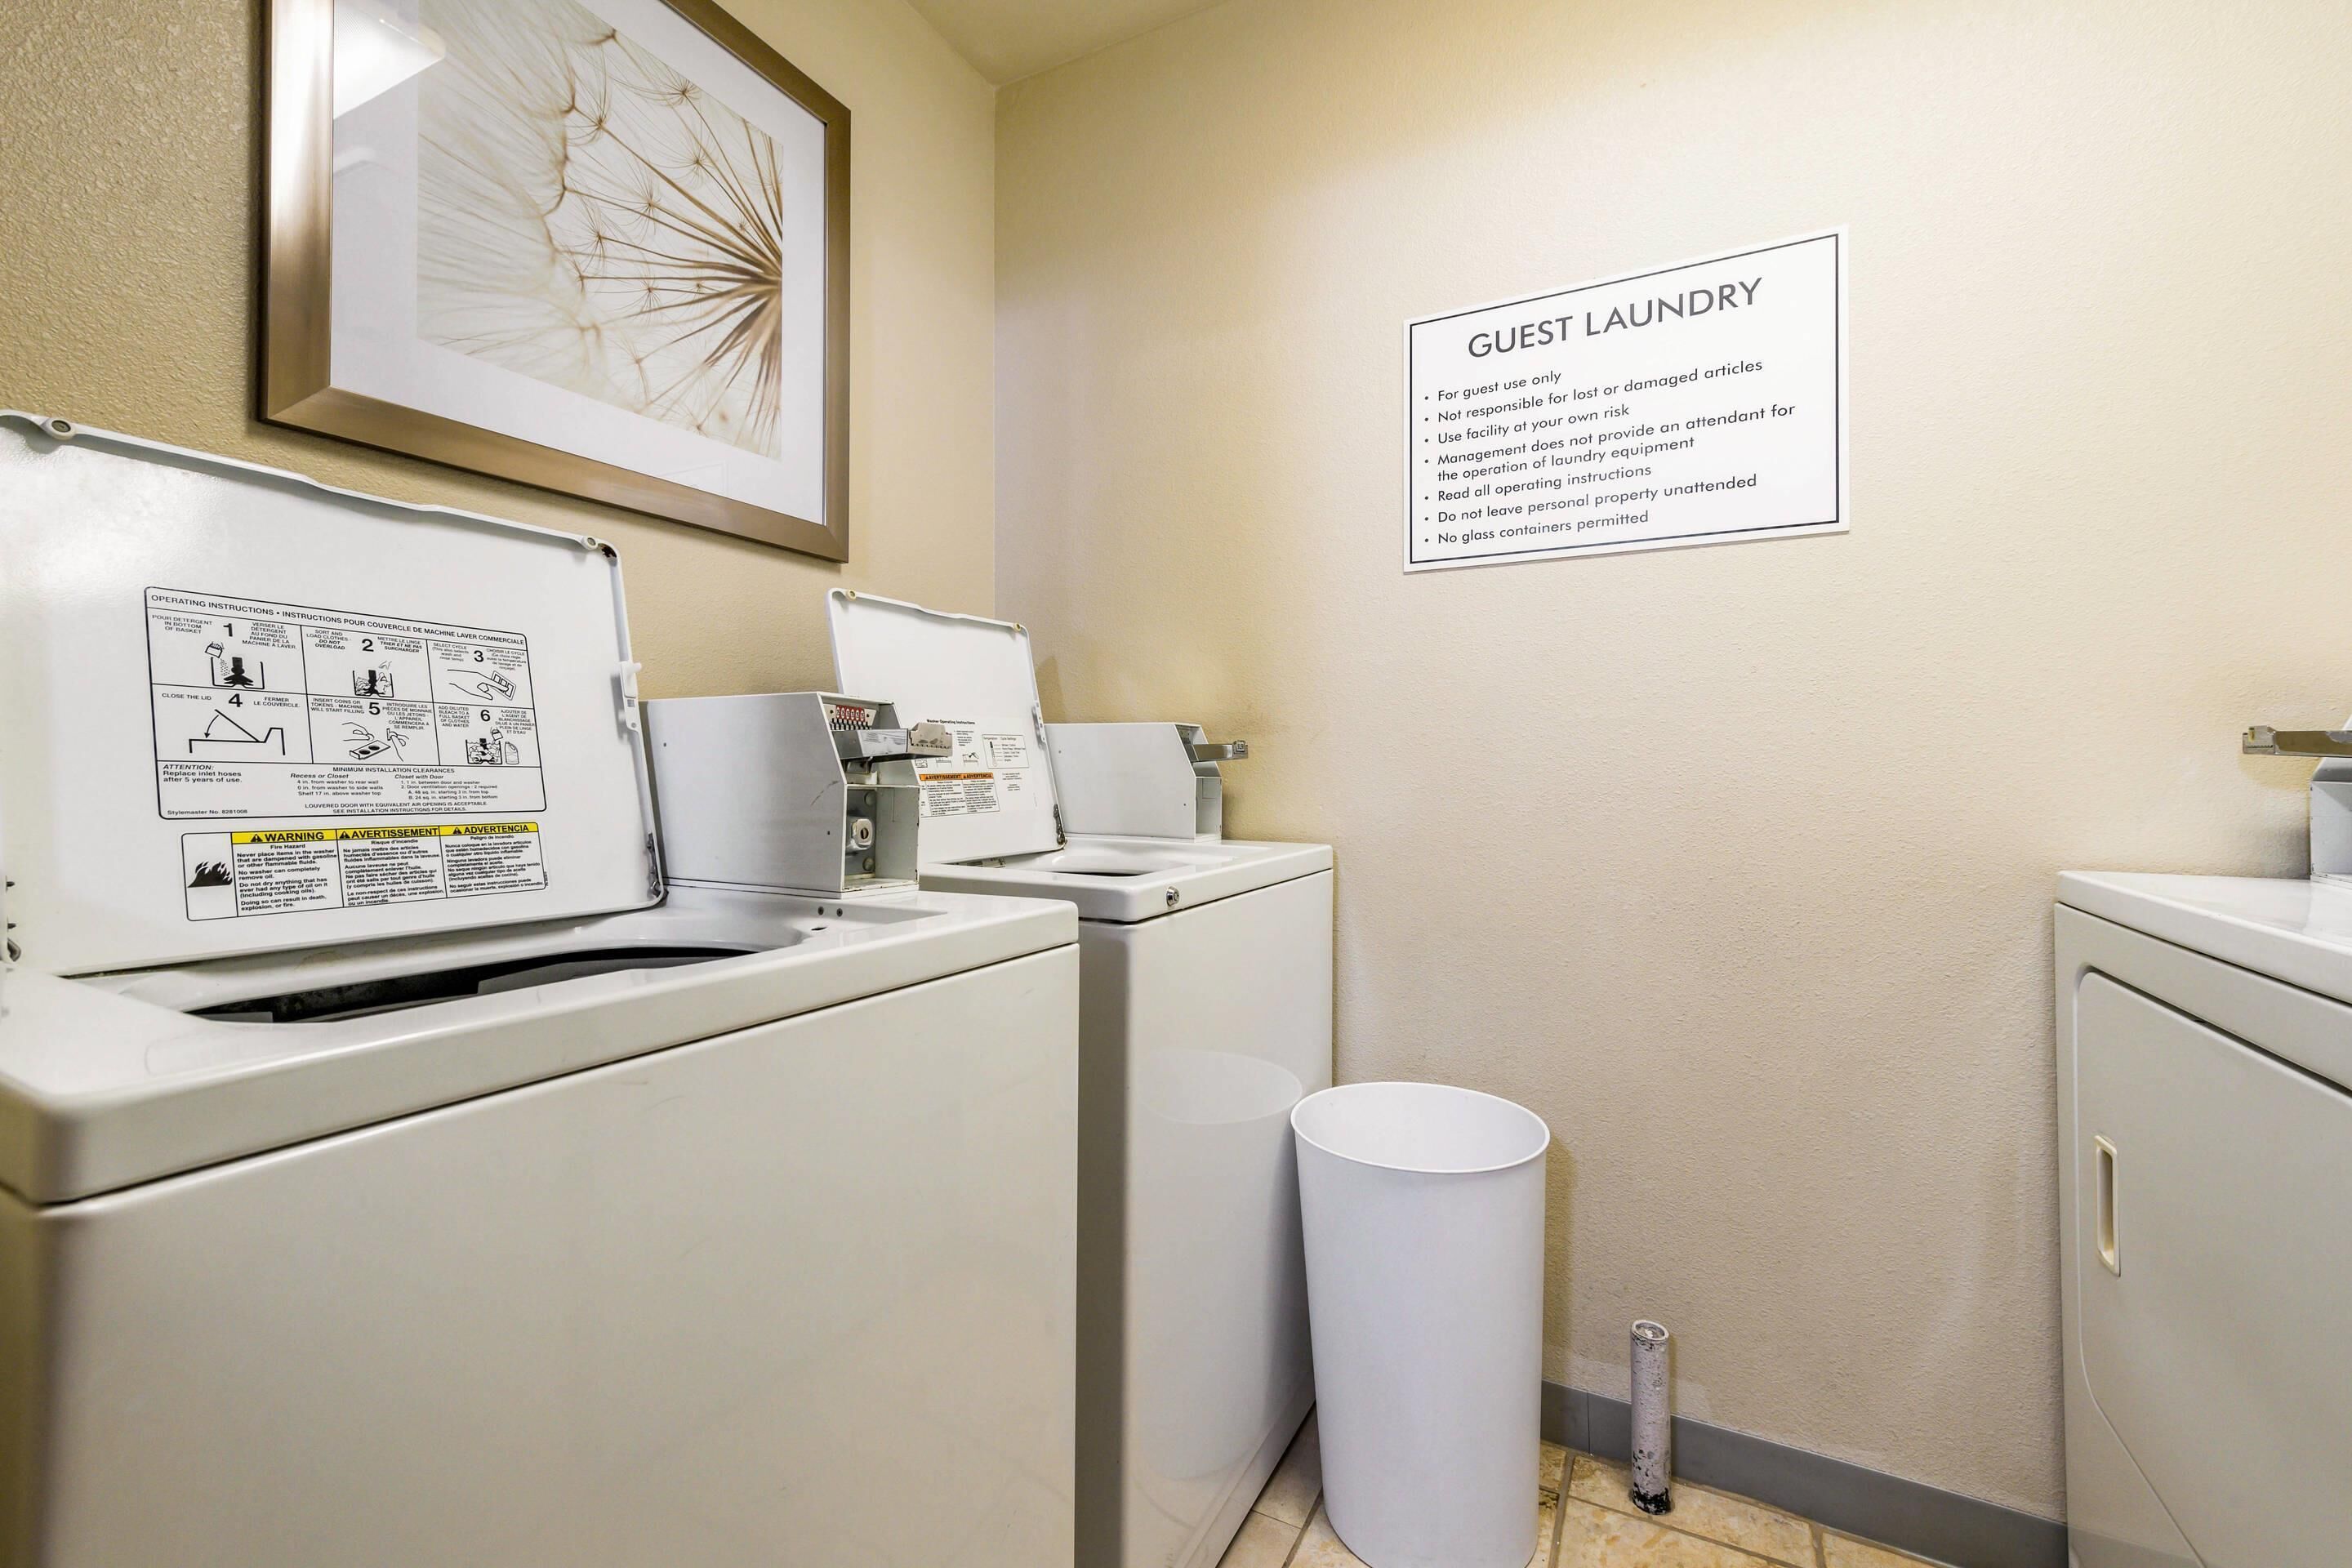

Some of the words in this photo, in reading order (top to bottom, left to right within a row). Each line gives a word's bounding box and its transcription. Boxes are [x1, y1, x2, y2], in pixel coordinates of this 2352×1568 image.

[1468, 316, 1572, 358] GUEST
[1587, 278, 1762, 336] LAUNDRY
[1439, 390, 1459, 401] For
[1463, 382, 1498, 399] guest
[1504, 380, 1526, 390] use
[1532, 371, 1561, 385] only
[1439, 410, 1461, 422] Not
[1467, 396, 1543, 418] responsible
[1548, 393, 1568, 404] for
[1574, 387, 1597, 400] lost
[1604, 385, 1619, 395] or
[1624, 368, 1697, 392] damaged
[1704, 361, 1762, 378] articles
[1437, 443, 1526, 465] Management
[1531, 439, 1564, 452] does
[1570, 434, 1592, 446] not
[1599, 424, 1654, 445] provide
[1660, 423, 1679, 433] an
[1686, 408, 1765, 430] attendant
[1771, 404, 1795, 416] for
[1439, 432, 1462, 443] Use
[1467, 425, 1508, 439] facility
[1514, 421, 1526, 432] at
[1532, 418, 1562, 433] your
[1568, 412, 1597, 424] own
[1605, 404, 1628, 418] risk
[1437, 470, 1458, 481] the
[1463, 461, 1527, 480] operation
[1533, 456, 1546, 469] of
[1552, 449, 1606, 466] laundry
[1611, 437, 1694, 459] equipment
[1439, 487, 1469, 501] Read
[1475, 484, 1490, 497] all
[1495, 478, 1561, 496] operating
[1568, 467, 1651, 485] instructions
[1439, 512, 1456, 523] Do
[1462, 509, 1481, 519] not
[1487, 506, 1522, 516] leave
[1529, 494, 1588, 515] personal
[1595, 488, 1658, 508] property
[1664, 474, 1756, 496] unattended
[1439, 532, 1457, 544] No
[1462, 529, 1494, 544] glass
[1499, 523, 1571, 537] containers
[1578, 510, 1648, 532] permitted
[151, 595, 206, 607] OPERATING
[209, 602, 274, 615] INSTRUCTIONS
[283, 611, 341, 623] INSTRUCTIONS
[368, 621, 411, 631] COUVERCLE
[424, 628, 455, 637] MACHINE
[479, 635, 524, 644] COMMERCIALE
[223, 623, 233, 637] 1
[362, 639, 374, 652] 2
[474, 650, 483, 662] 3
[229, 693, 243, 707] 4
[369, 702, 381, 715] 5
[480, 710, 490, 722] 6
[265, 831, 324, 842] WARNING
[351, 828, 439, 839] AVERTISSEMENT
[464, 825, 528, 834] ADVERTENCIA
